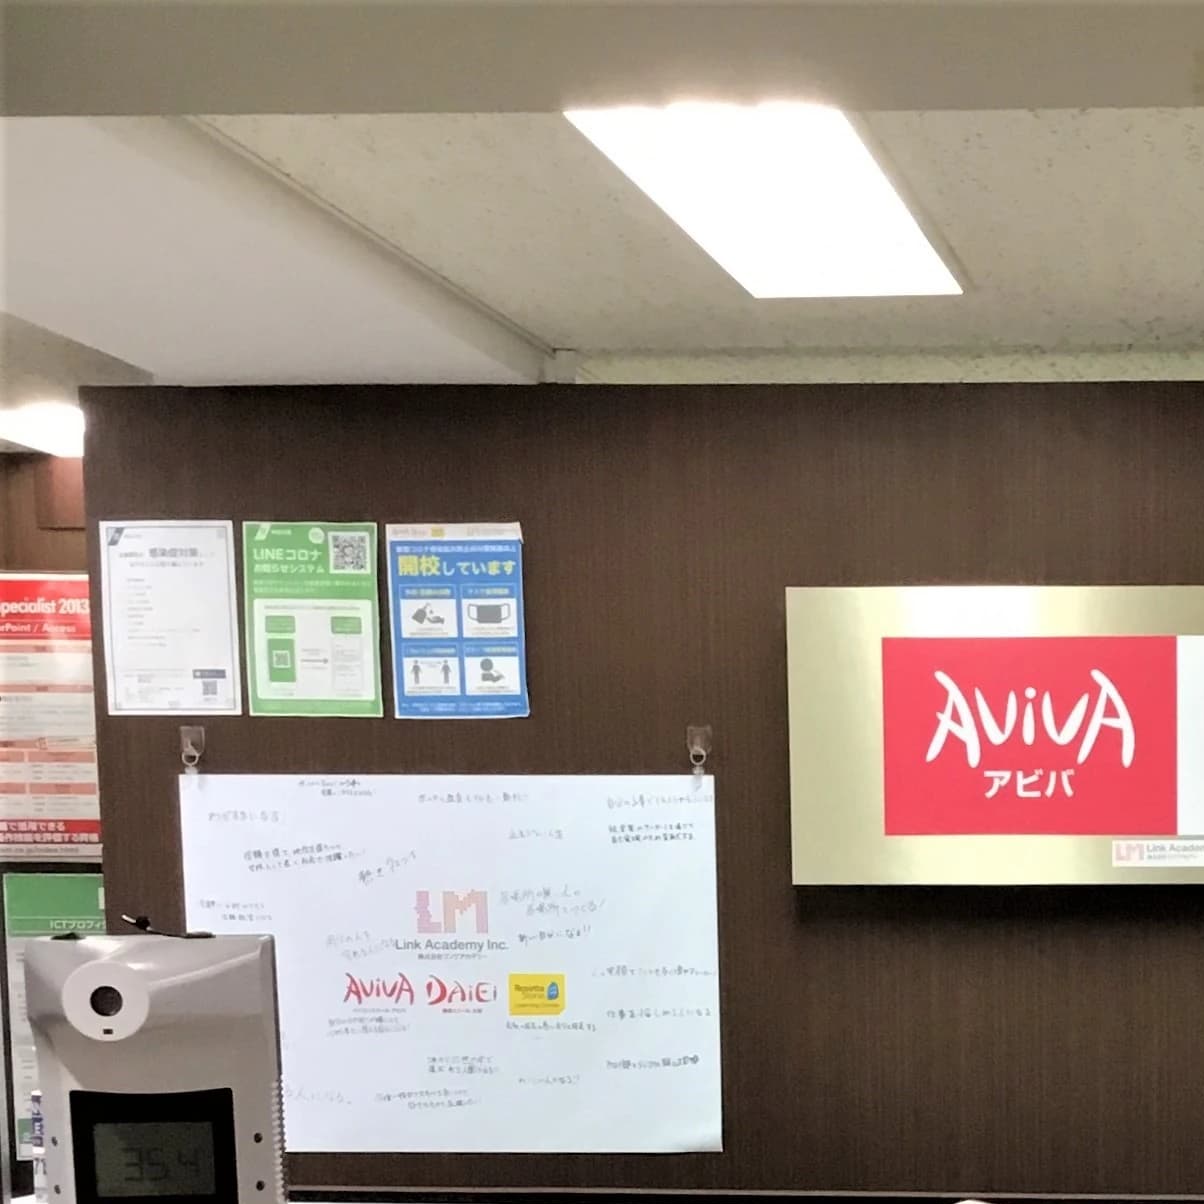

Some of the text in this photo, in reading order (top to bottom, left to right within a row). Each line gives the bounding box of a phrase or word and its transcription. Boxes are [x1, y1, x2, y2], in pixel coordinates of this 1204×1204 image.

[252, 548, 323, 561] LINEコロナ
[397, 554, 516, 577] 開校しています
[0, 597, 56, 618] pecialist
[985, 769, 1074, 799] アビバ
[1146, 843, 1167, 852] Link
[49, 919, 106, 930] ICTプロフィ
[395, 939, 422, 950] Link
[424, 939, 485, 953] Academy
[487, 939, 510, 951] Inc.
